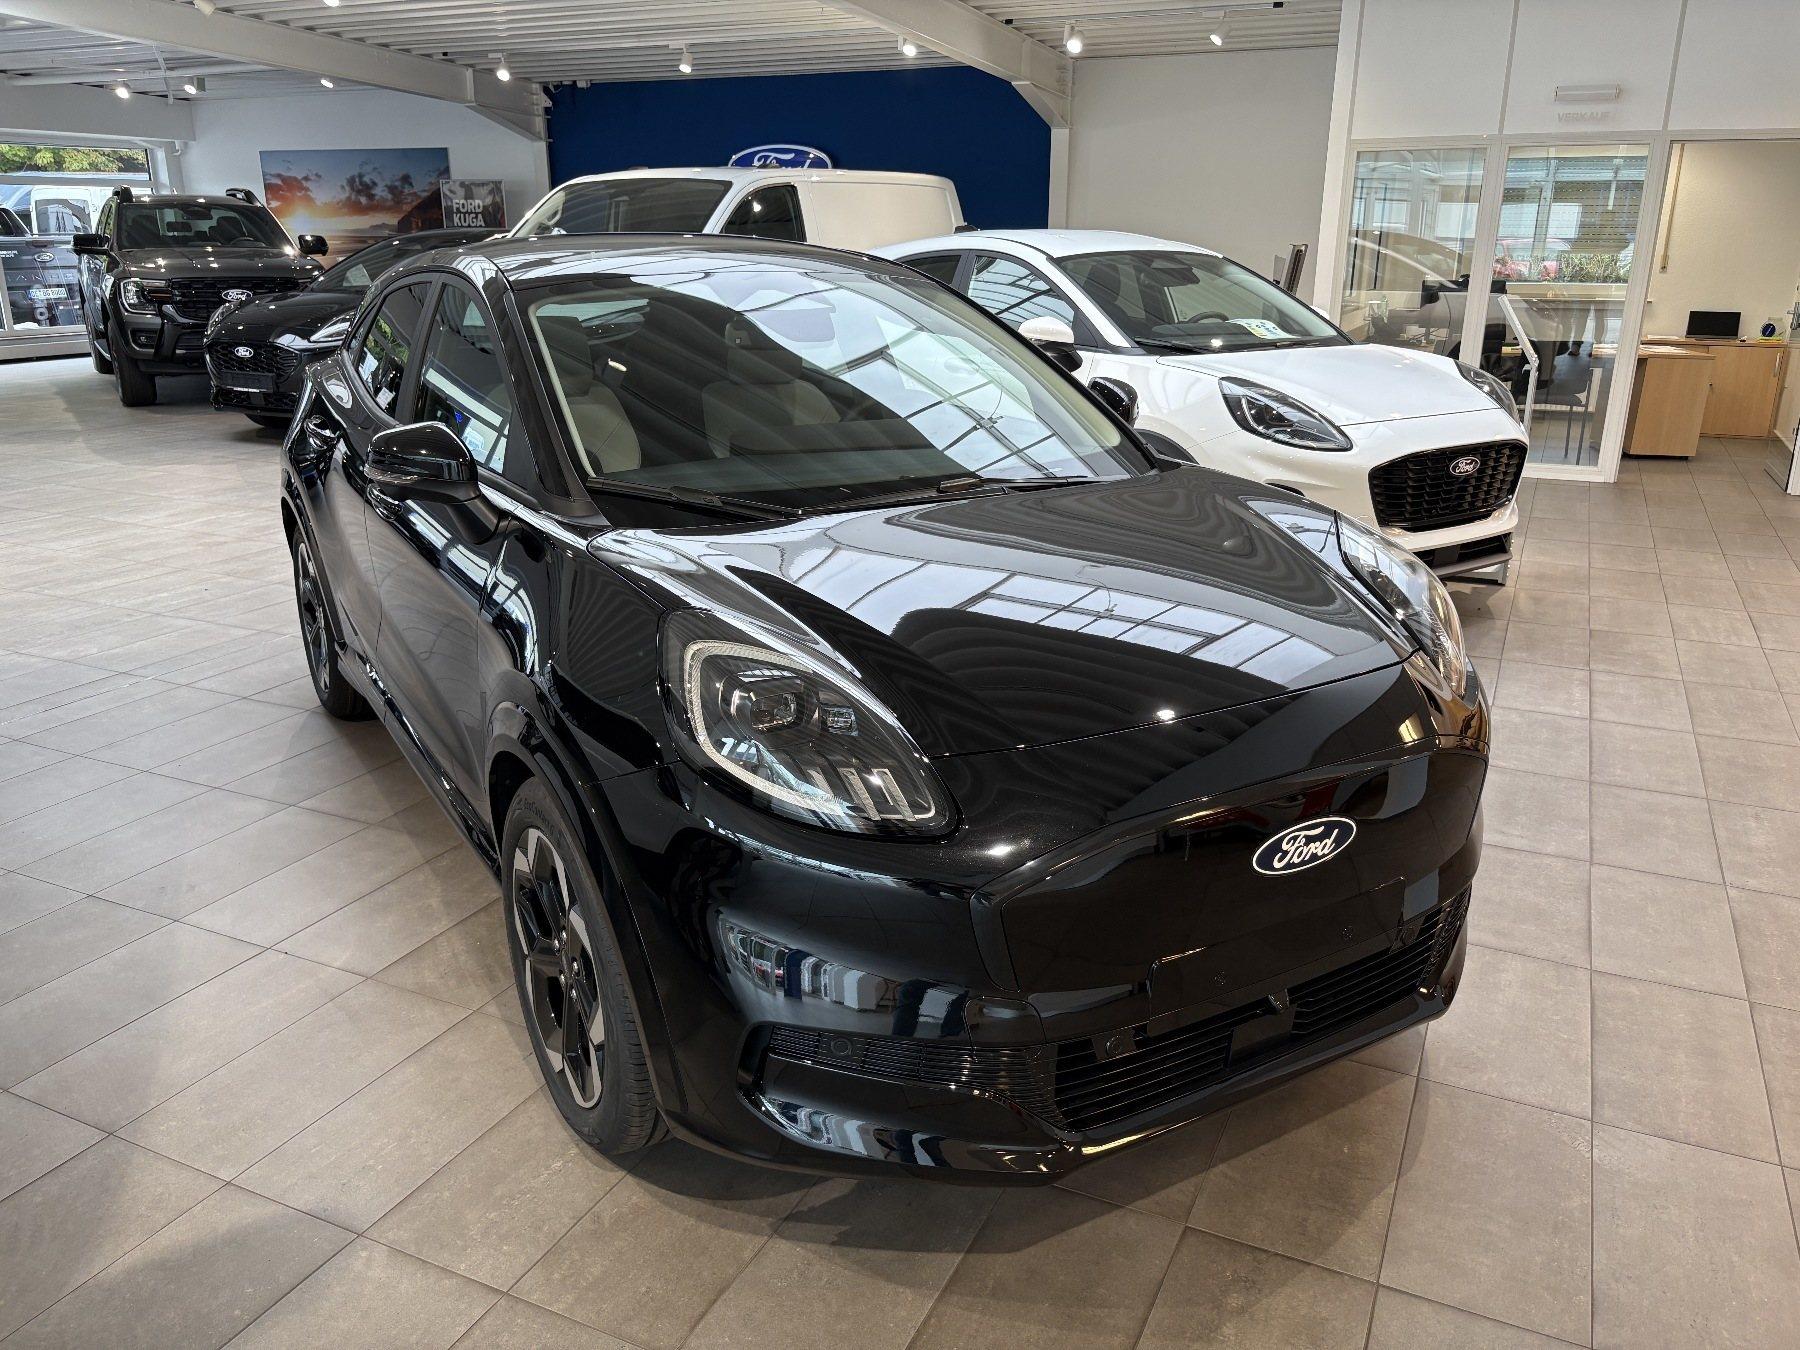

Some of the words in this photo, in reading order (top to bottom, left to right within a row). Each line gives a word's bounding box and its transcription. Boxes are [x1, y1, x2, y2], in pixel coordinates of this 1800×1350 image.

[1557, 111, 1611, 122] VERKAUF
[453, 200, 483, 212] FORD
[453, 214, 485, 226] KUGA
[1273, 825, 1339, 869] Ford
